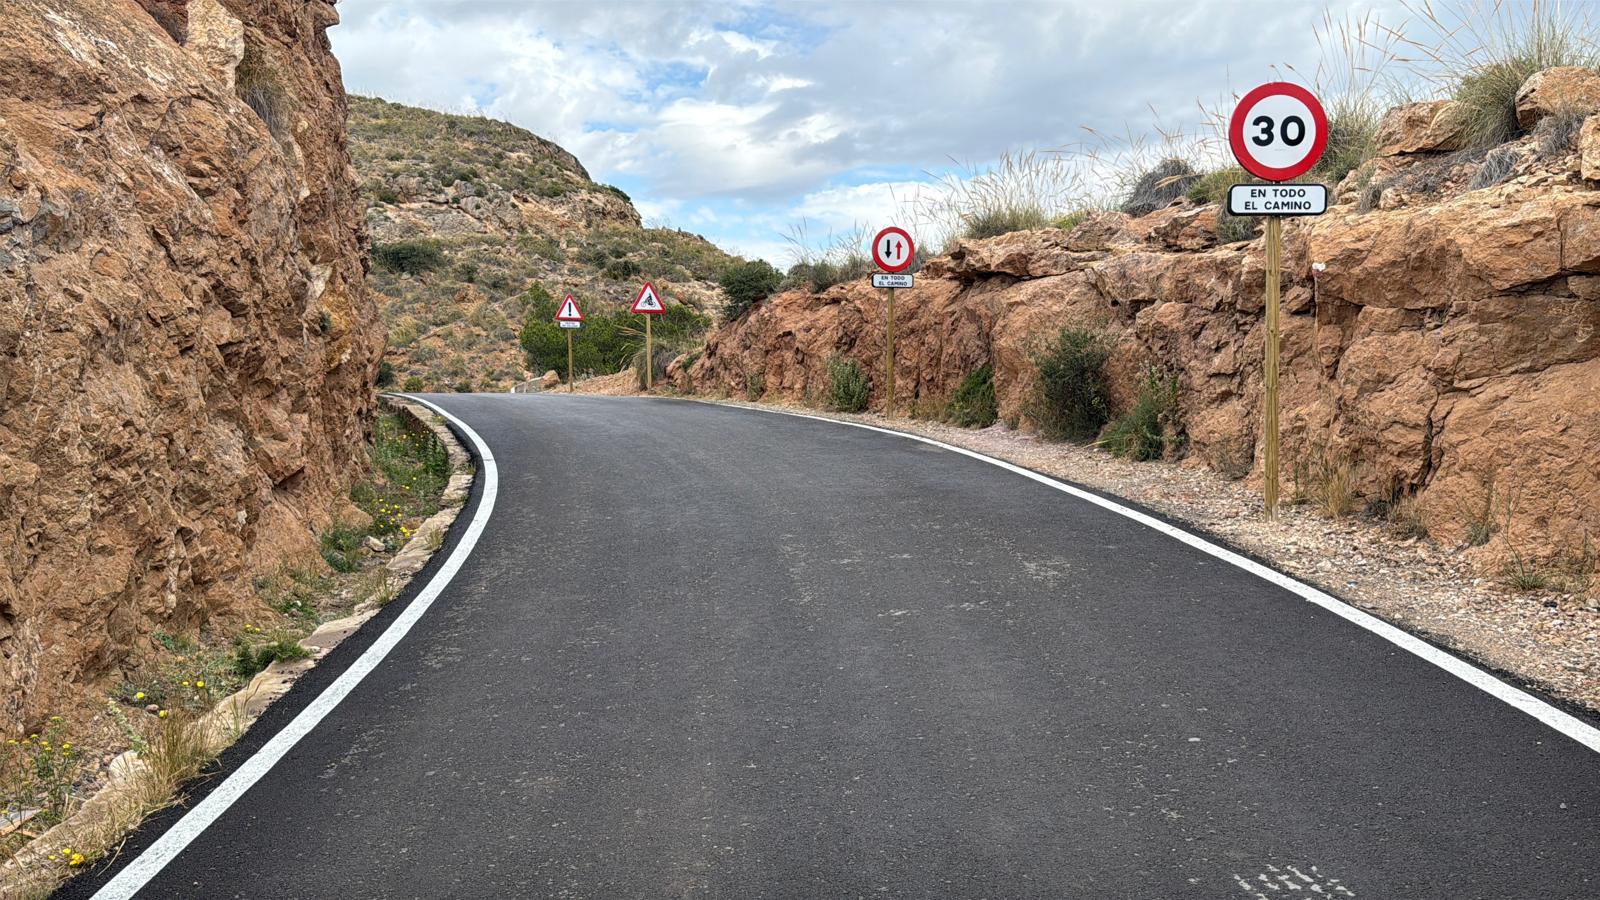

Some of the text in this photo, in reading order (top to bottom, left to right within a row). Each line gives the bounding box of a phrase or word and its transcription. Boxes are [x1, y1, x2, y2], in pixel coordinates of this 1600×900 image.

[1252, 115, 1306, 147] 30
[1250, 189, 1306, 198] EN TODO
[1244, 201, 1312, 210] EL CAMINO
